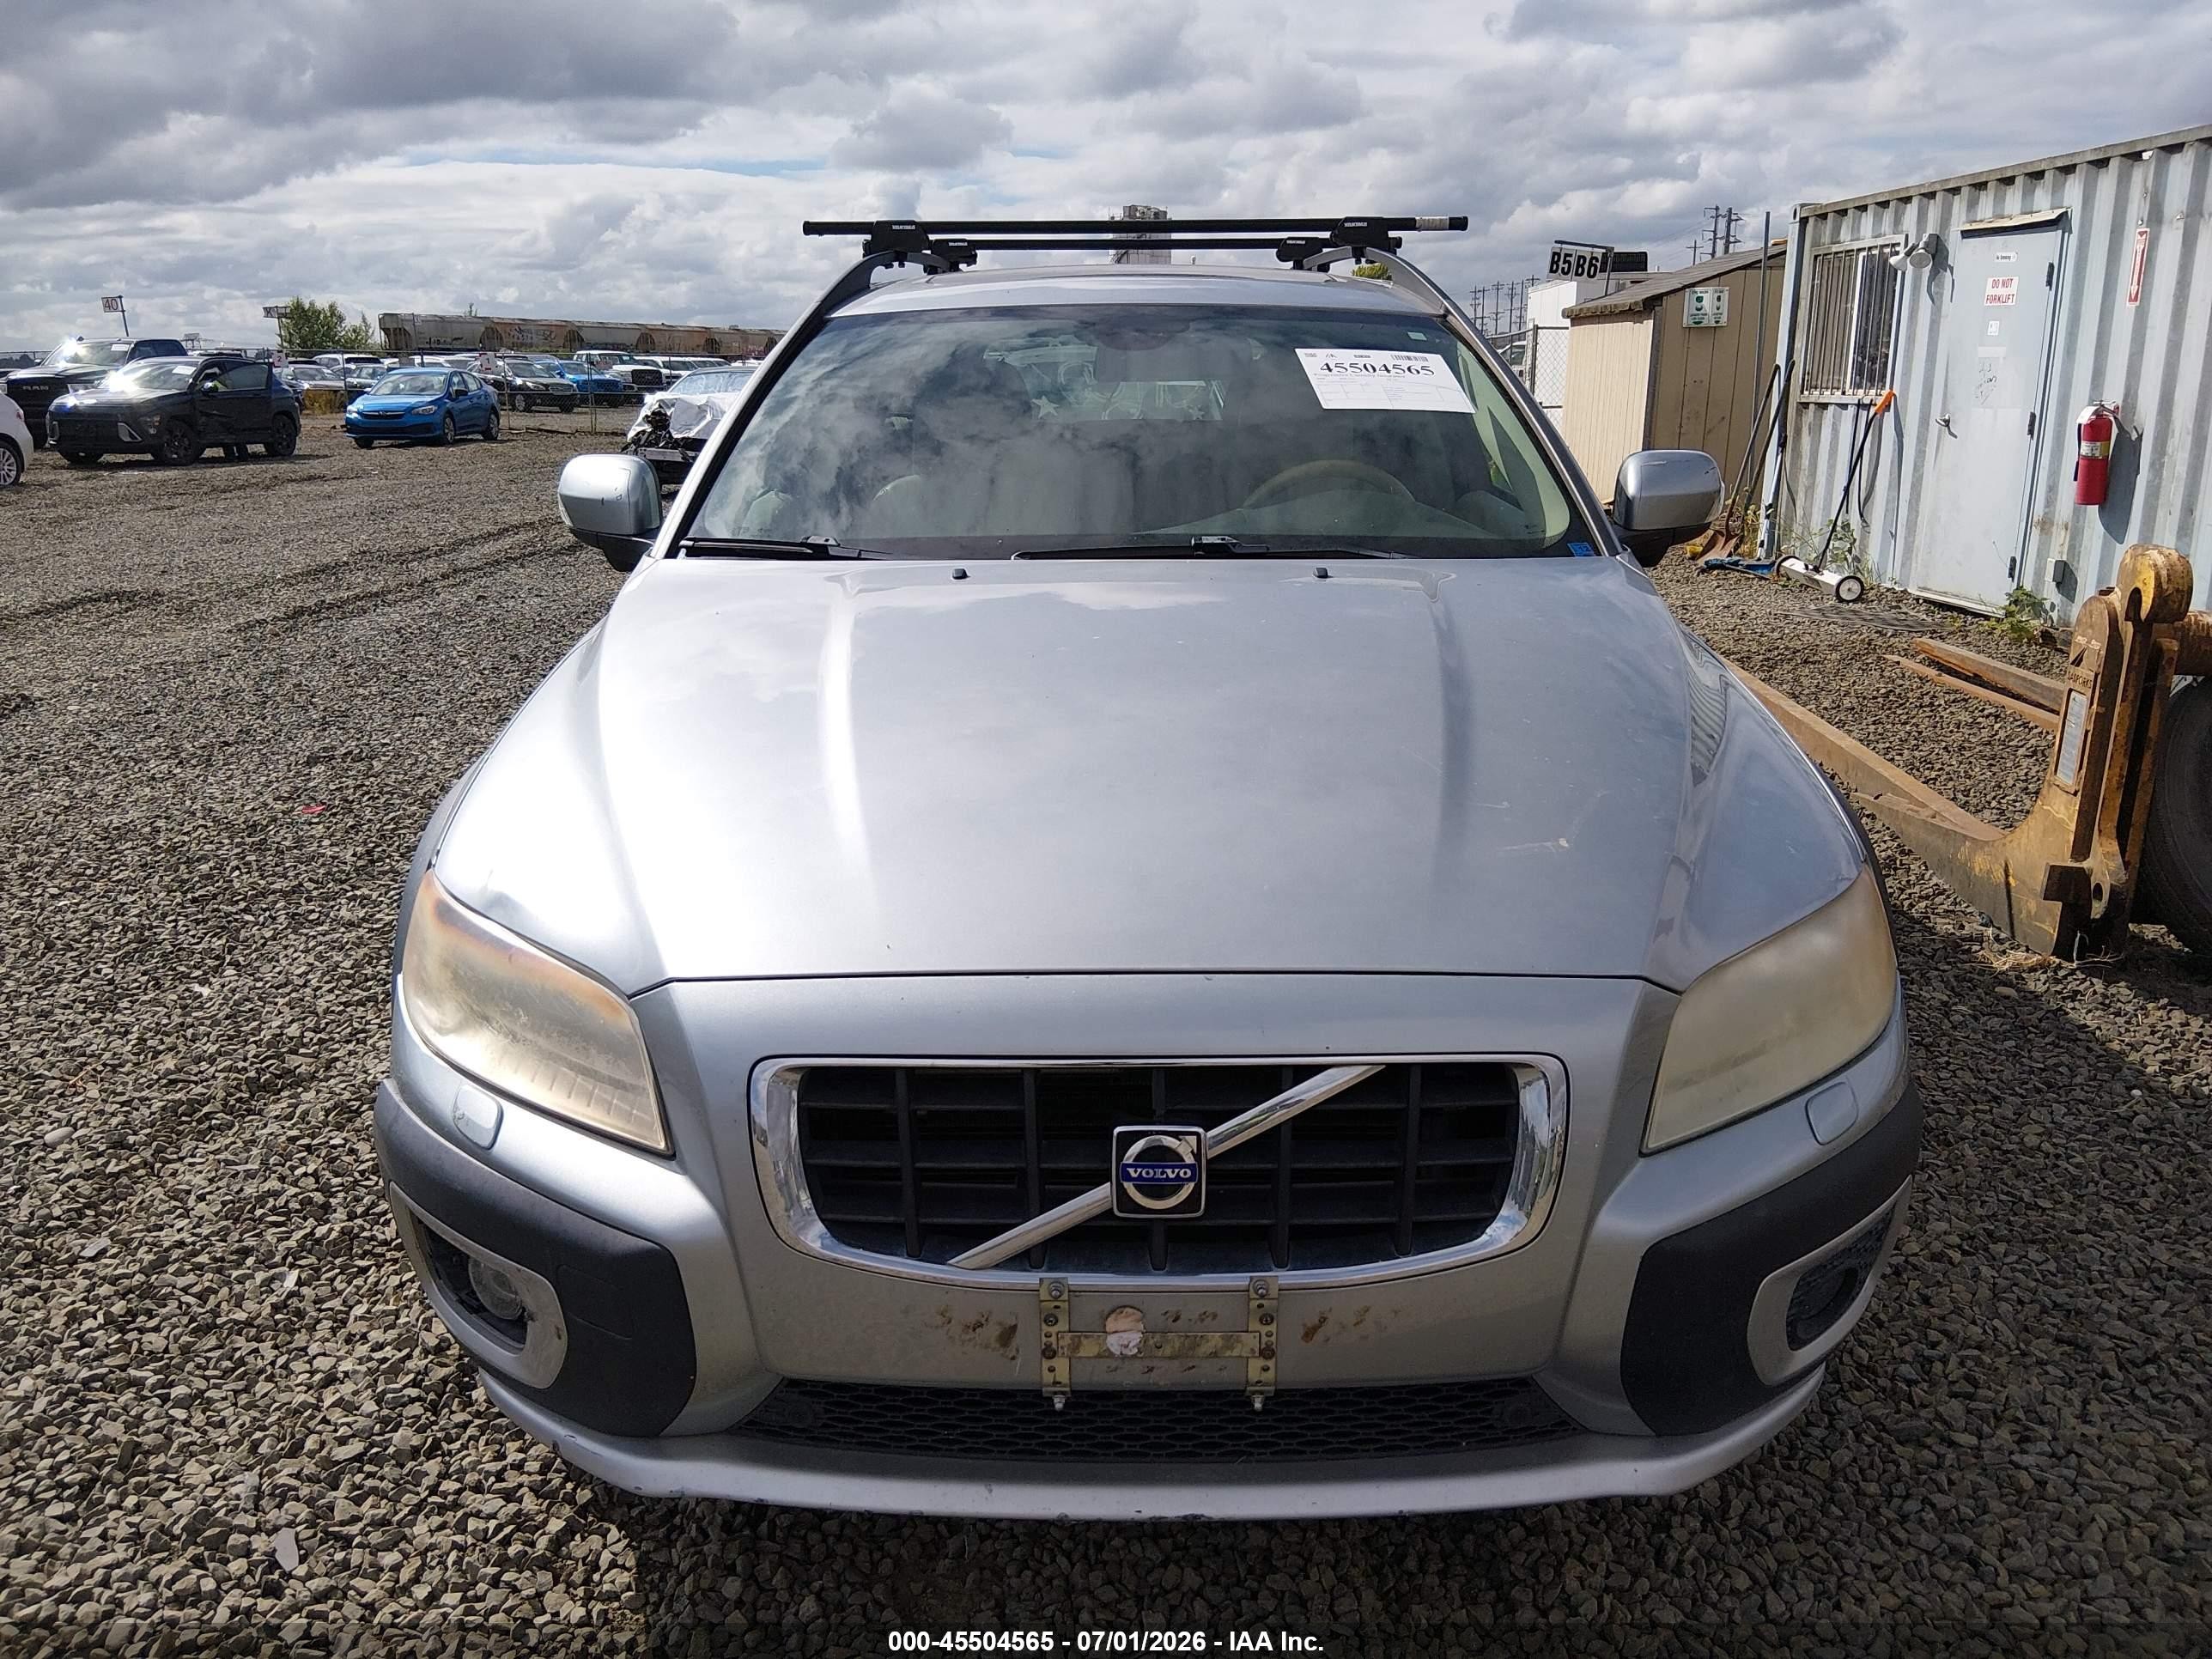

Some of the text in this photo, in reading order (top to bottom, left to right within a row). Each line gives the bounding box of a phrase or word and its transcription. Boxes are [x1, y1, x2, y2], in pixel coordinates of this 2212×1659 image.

[1991, 278, 2014, 289] DO NOT
[104, 298, 118, 310] 40
[1986, 294, 2014, 304] FORKLIFT
[1320, 362, 1435, 376] 45504565
[1127, 1168, 1192, 1179] VOLVO
